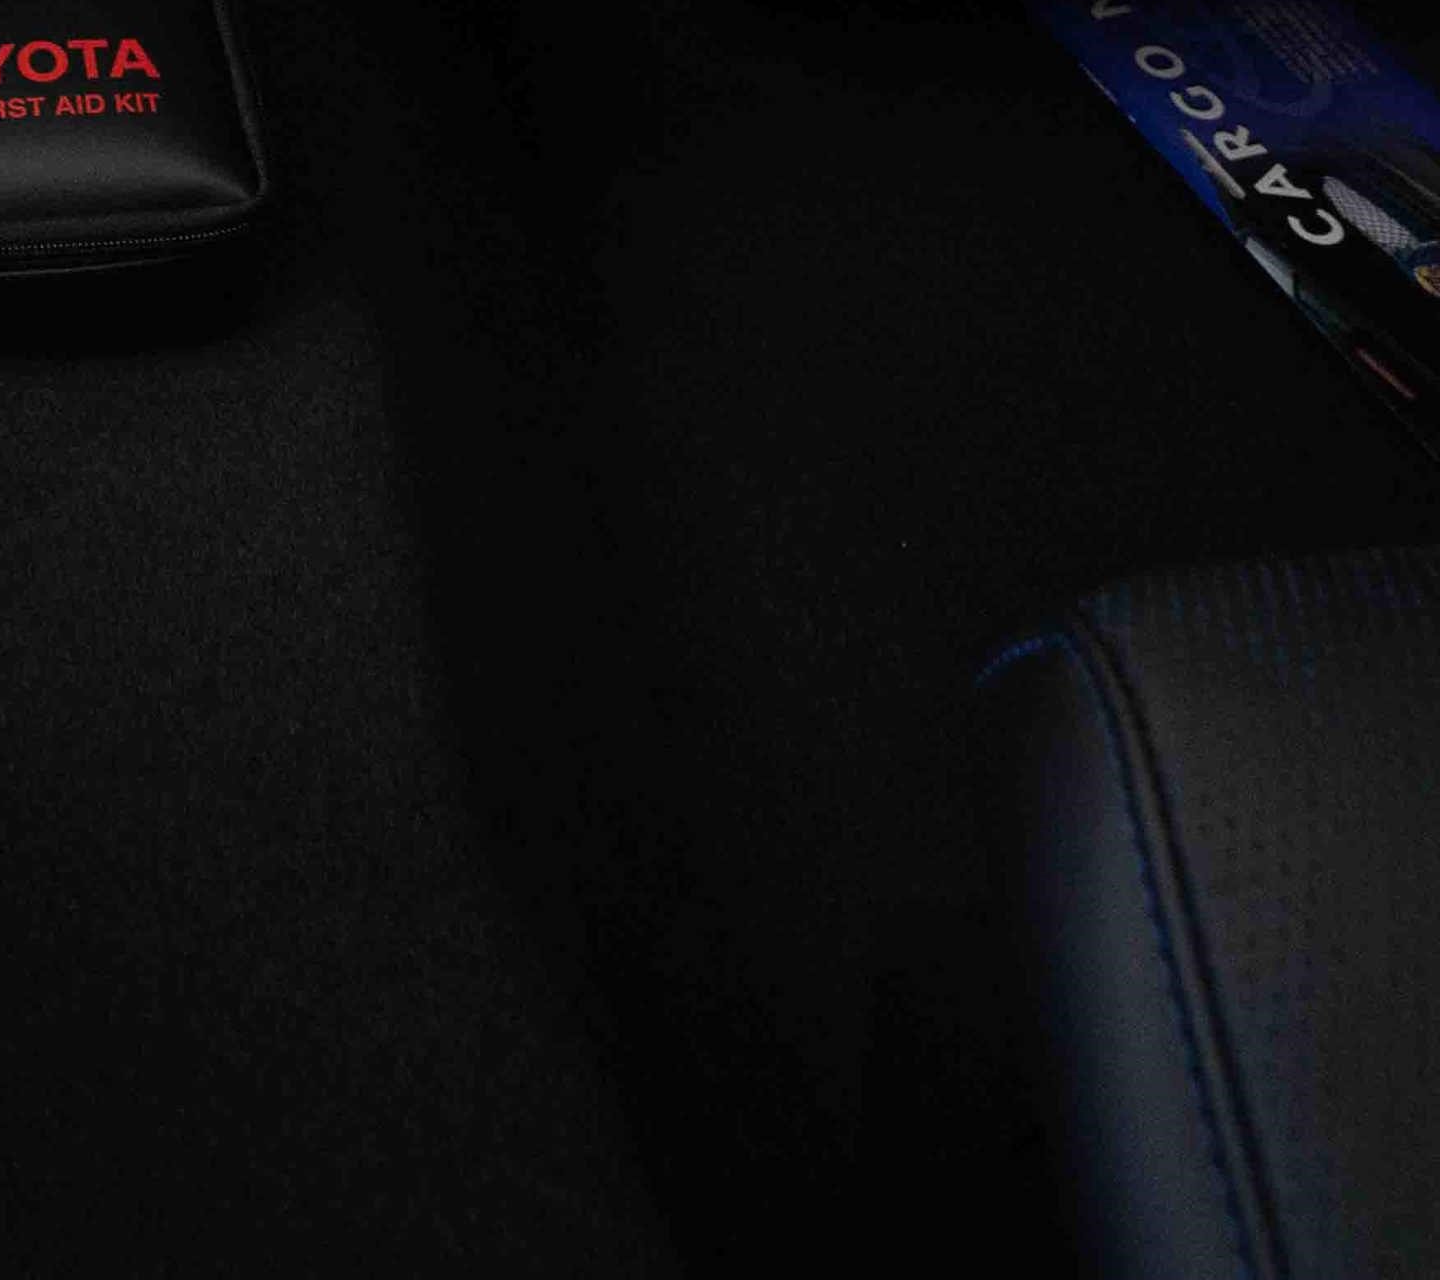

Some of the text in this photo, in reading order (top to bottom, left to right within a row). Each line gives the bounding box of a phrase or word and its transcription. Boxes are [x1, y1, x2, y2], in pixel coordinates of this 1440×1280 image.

[56, 94, 106, 116] AID
[115, 92, 159, 114] KIT
[1134, 45, 1344, 245] CARGO
